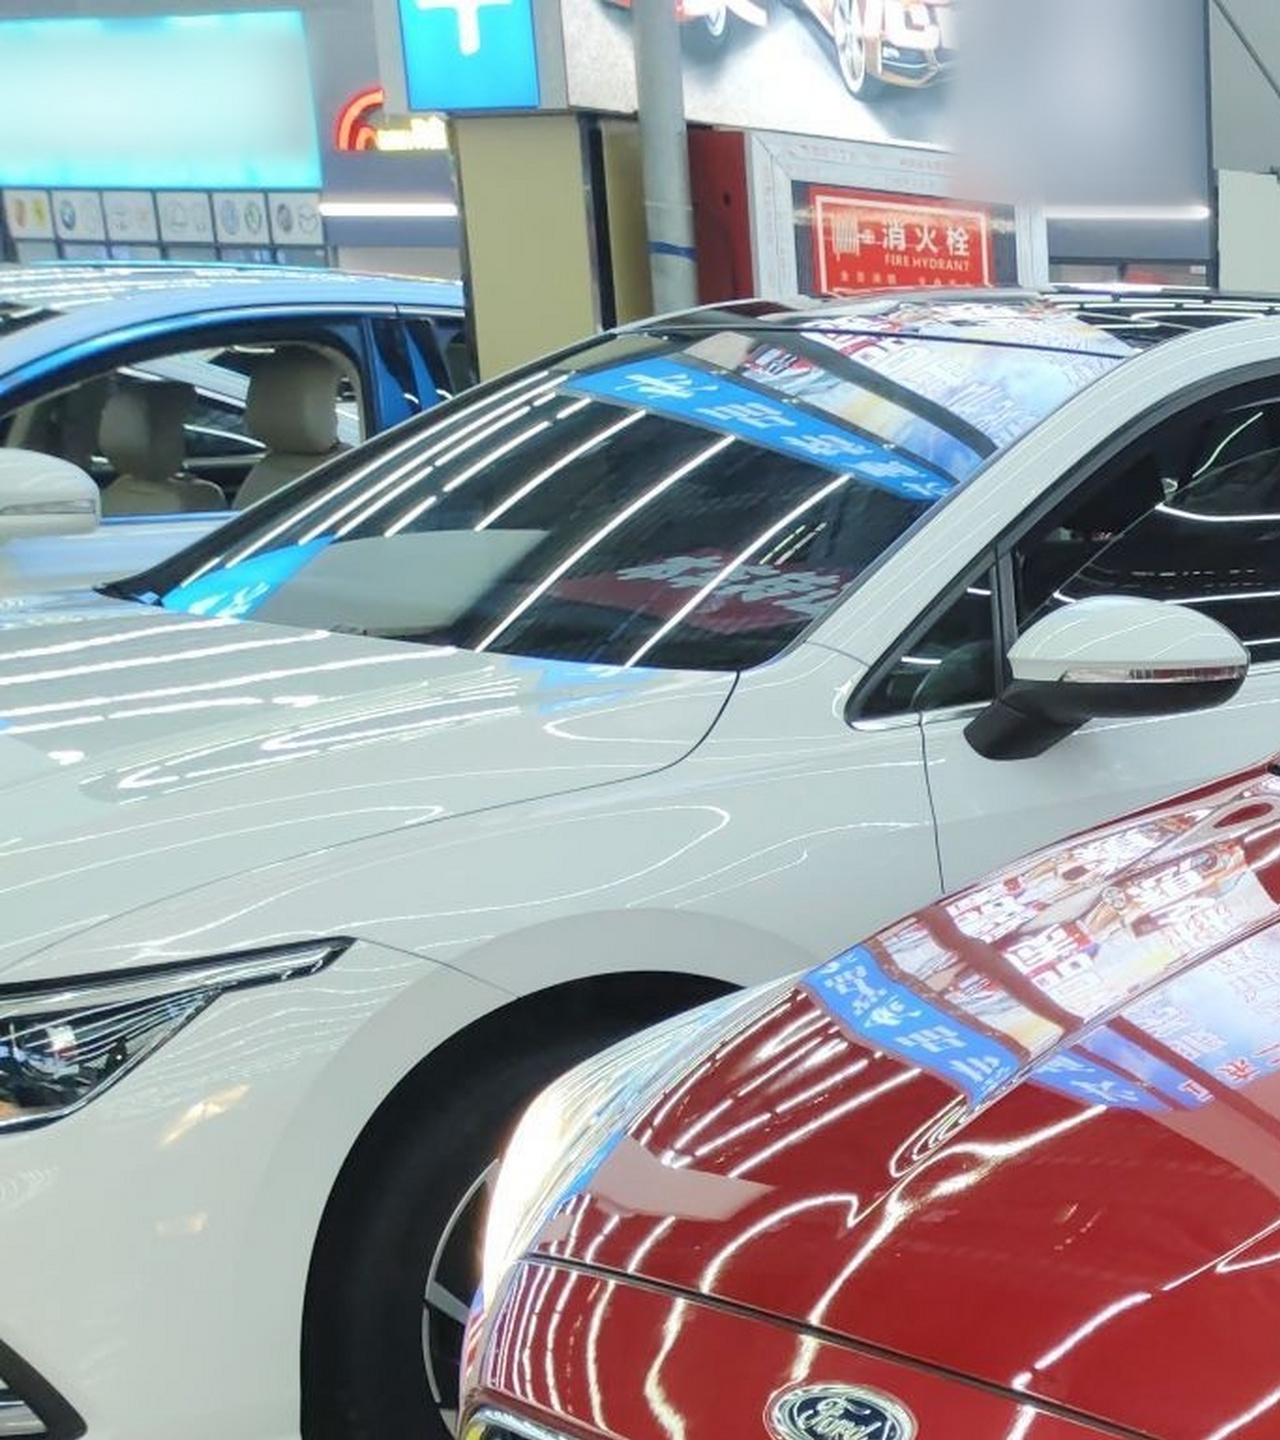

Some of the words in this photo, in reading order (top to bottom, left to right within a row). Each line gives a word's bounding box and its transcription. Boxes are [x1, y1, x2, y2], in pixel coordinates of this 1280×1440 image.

[882, 217, 970, 256] 消火栓
[884, 253, 910, 267] FIRE
[912, 257, 971, 272] HYDRANT
